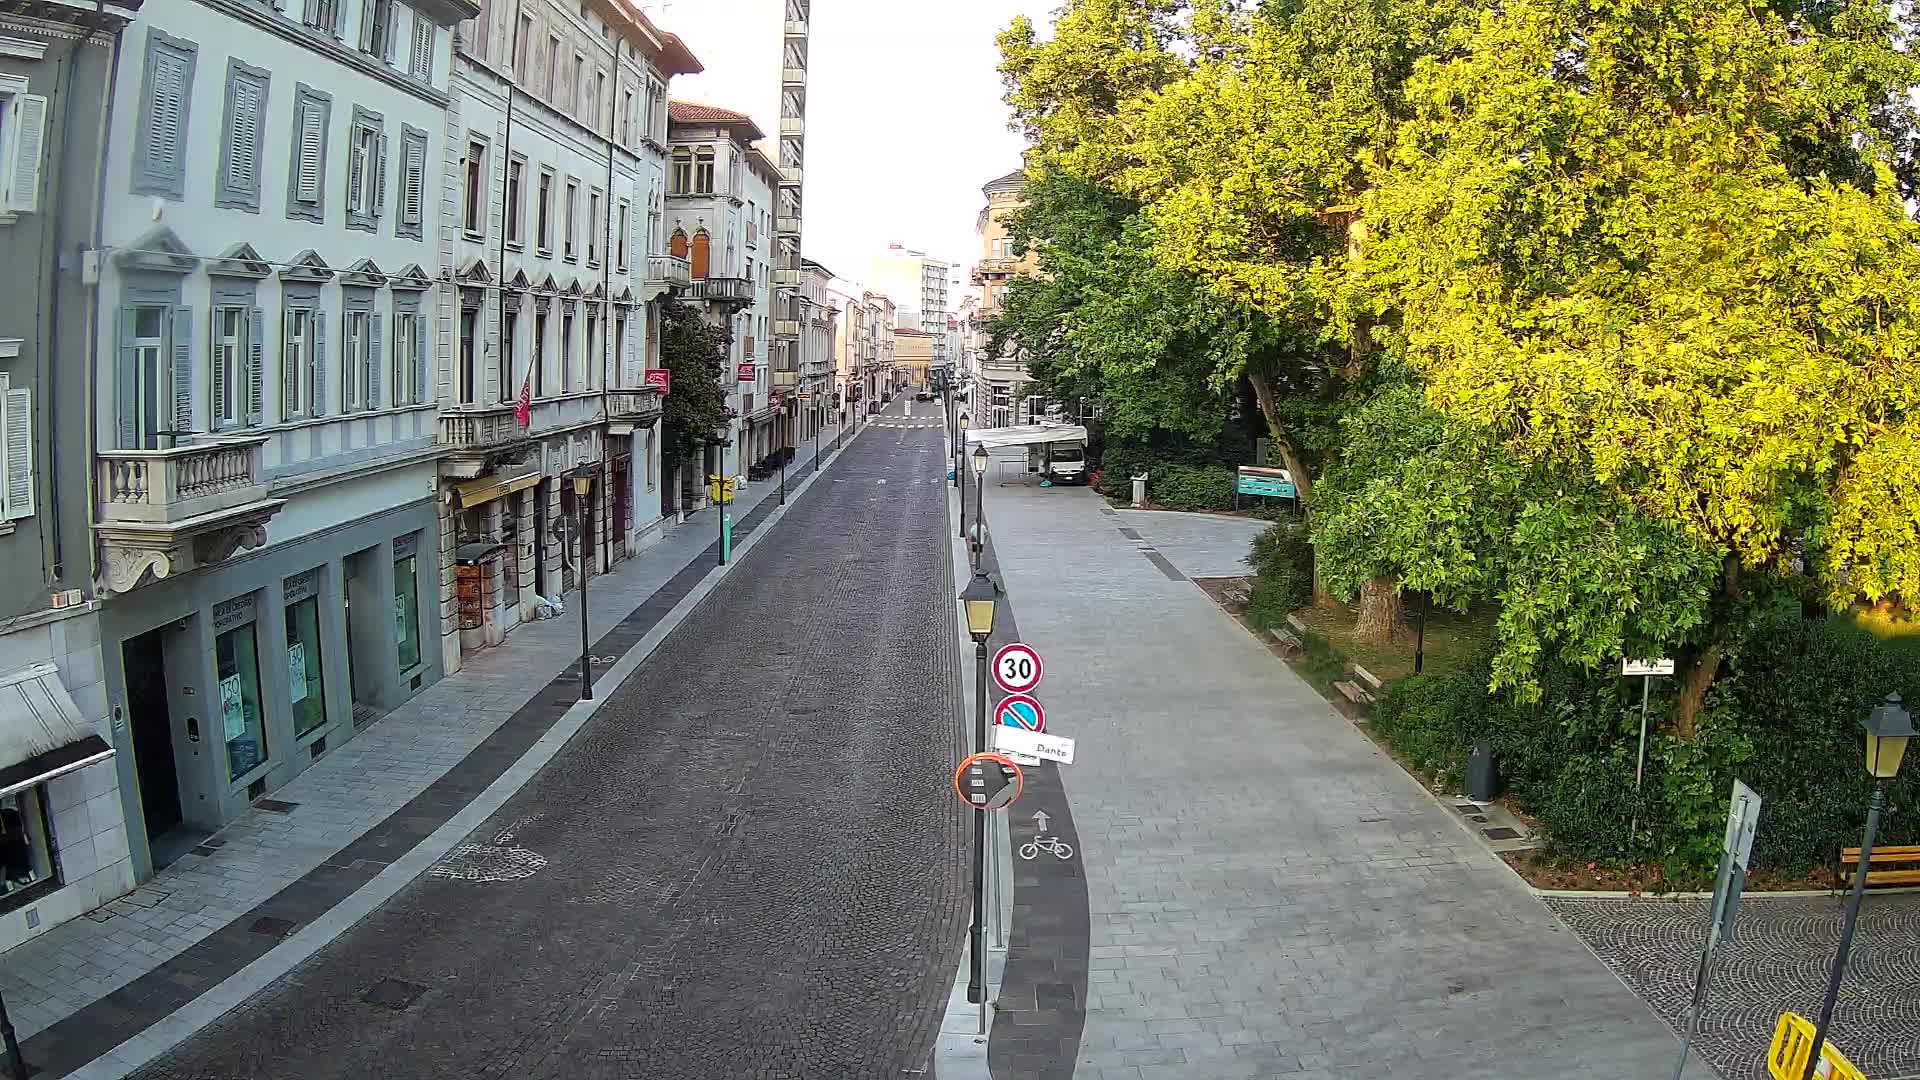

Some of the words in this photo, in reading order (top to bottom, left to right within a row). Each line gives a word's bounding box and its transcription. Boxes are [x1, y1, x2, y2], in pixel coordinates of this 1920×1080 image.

[1004, 658, 1031, 679] 30
[221, 677, 239, 701] 130
[1036, 743, 1067, 757] Dante
